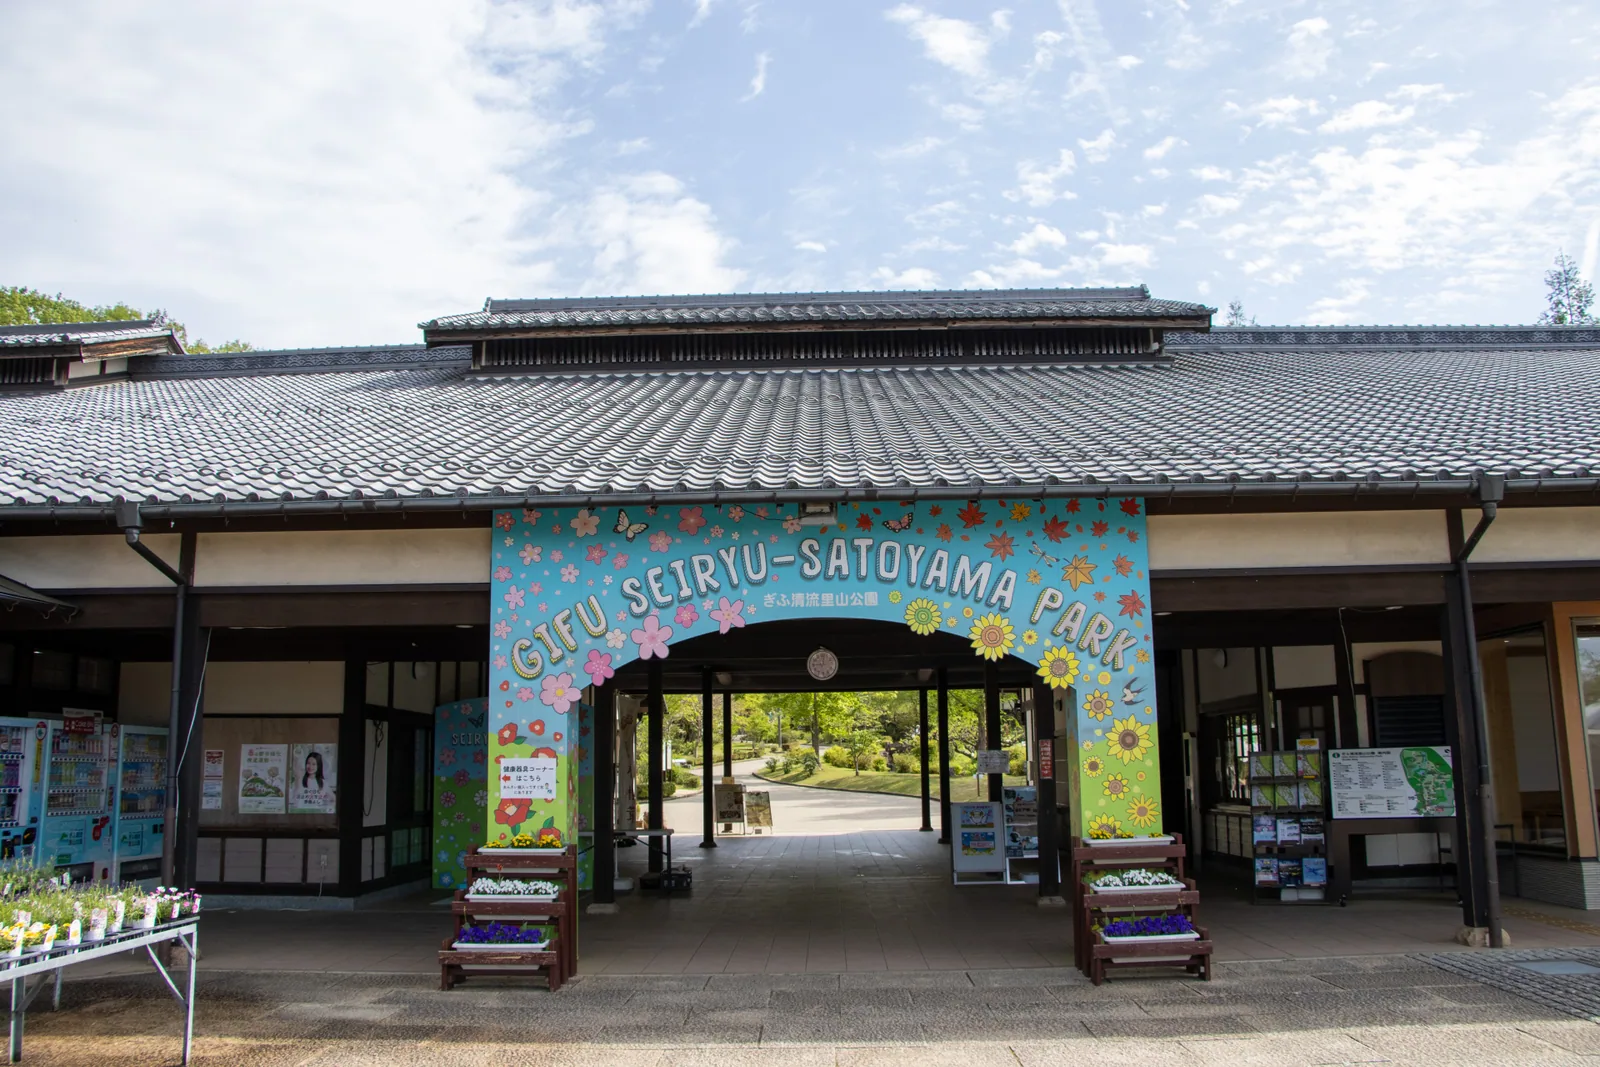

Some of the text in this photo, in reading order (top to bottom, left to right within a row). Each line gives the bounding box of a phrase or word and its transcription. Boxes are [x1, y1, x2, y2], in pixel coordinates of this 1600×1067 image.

[763, 591, 879, 608] ぎふ清流里山公園
[511, 594, 608, 679] GIFU
[1030, 587, 1138, 671] PARK
